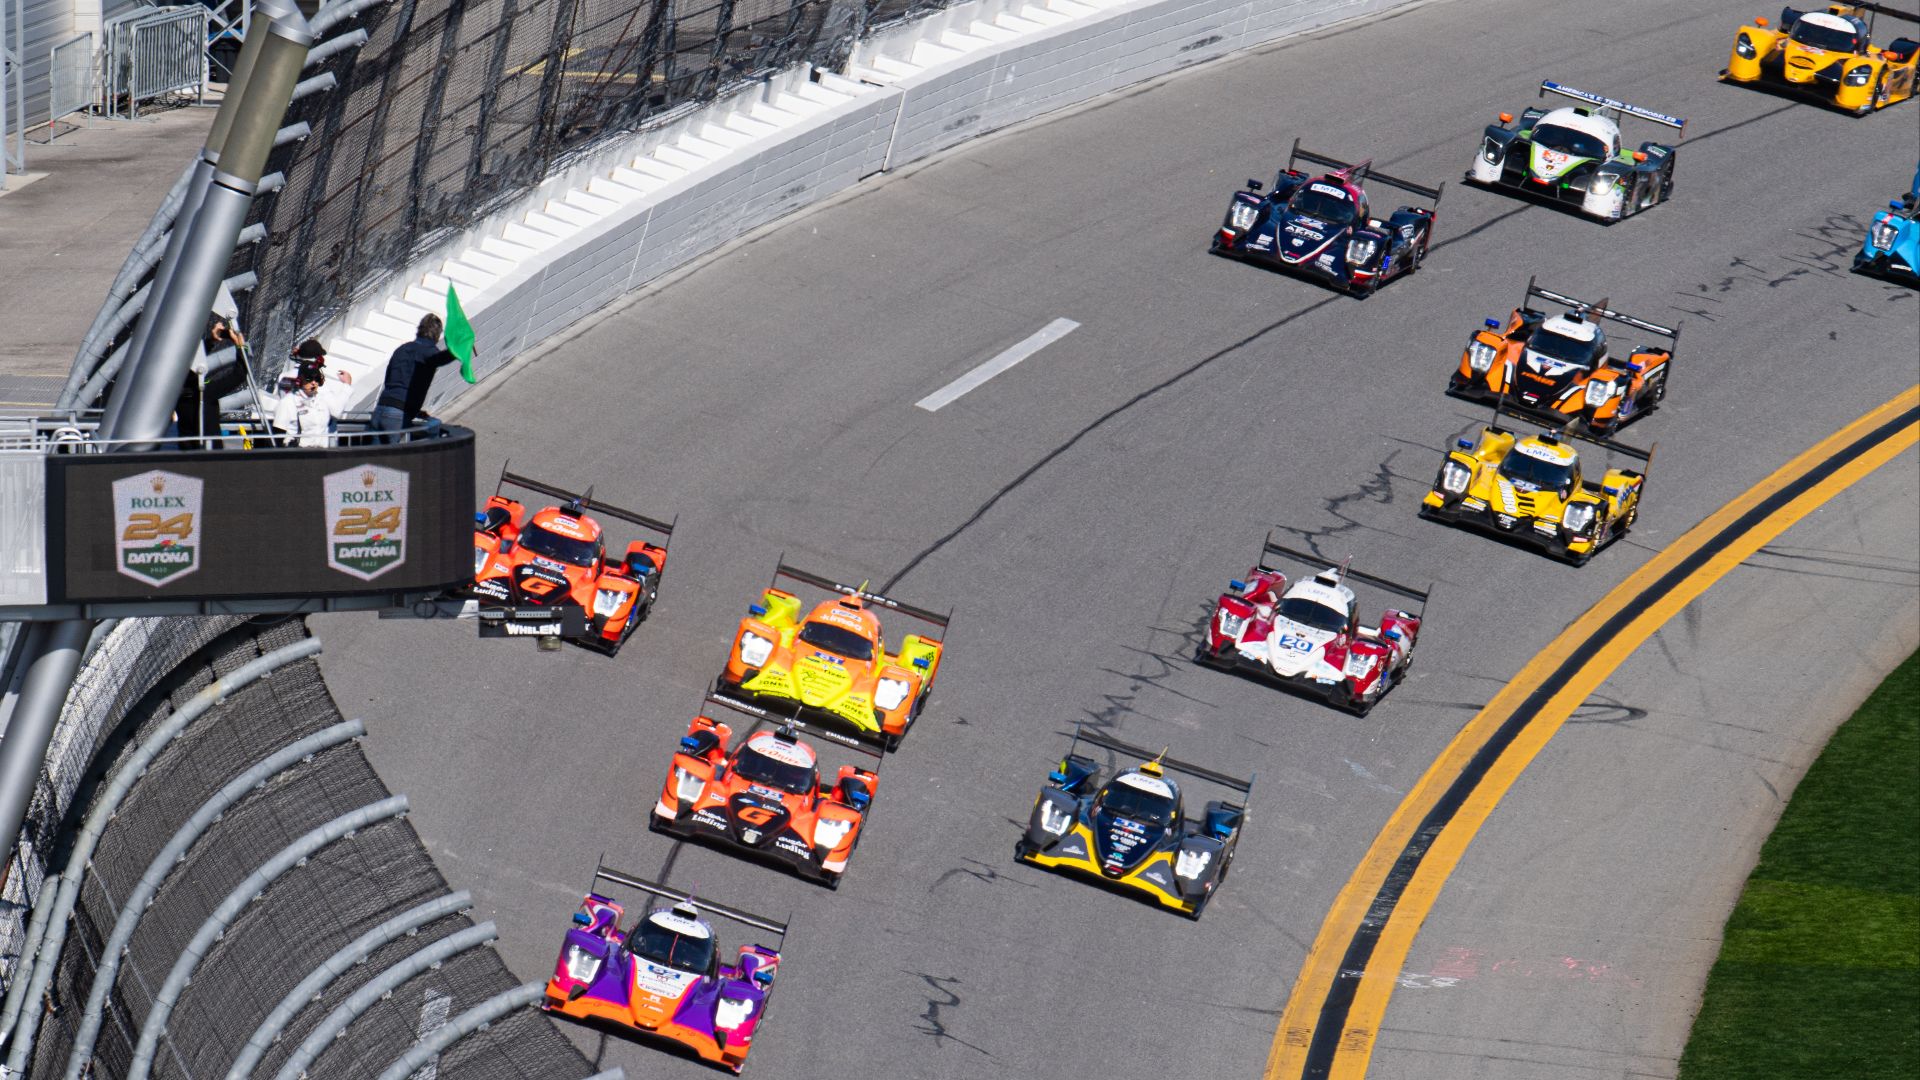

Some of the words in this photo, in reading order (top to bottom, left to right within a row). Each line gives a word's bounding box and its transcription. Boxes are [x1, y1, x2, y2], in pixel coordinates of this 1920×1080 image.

[1526, 448, 1556, 461] LMP2
[131, 496, 185, 509] ROLEX
[341, 490, 394, 503] ROLEX
[123, 513, 193, 541] 24
[333, 506, 402, 535] 24
[127, 552, 190, 564] DAYTONA
[339, 545, 397, 558] DAYTONA
[1281, 637, 1311, 651] 20
